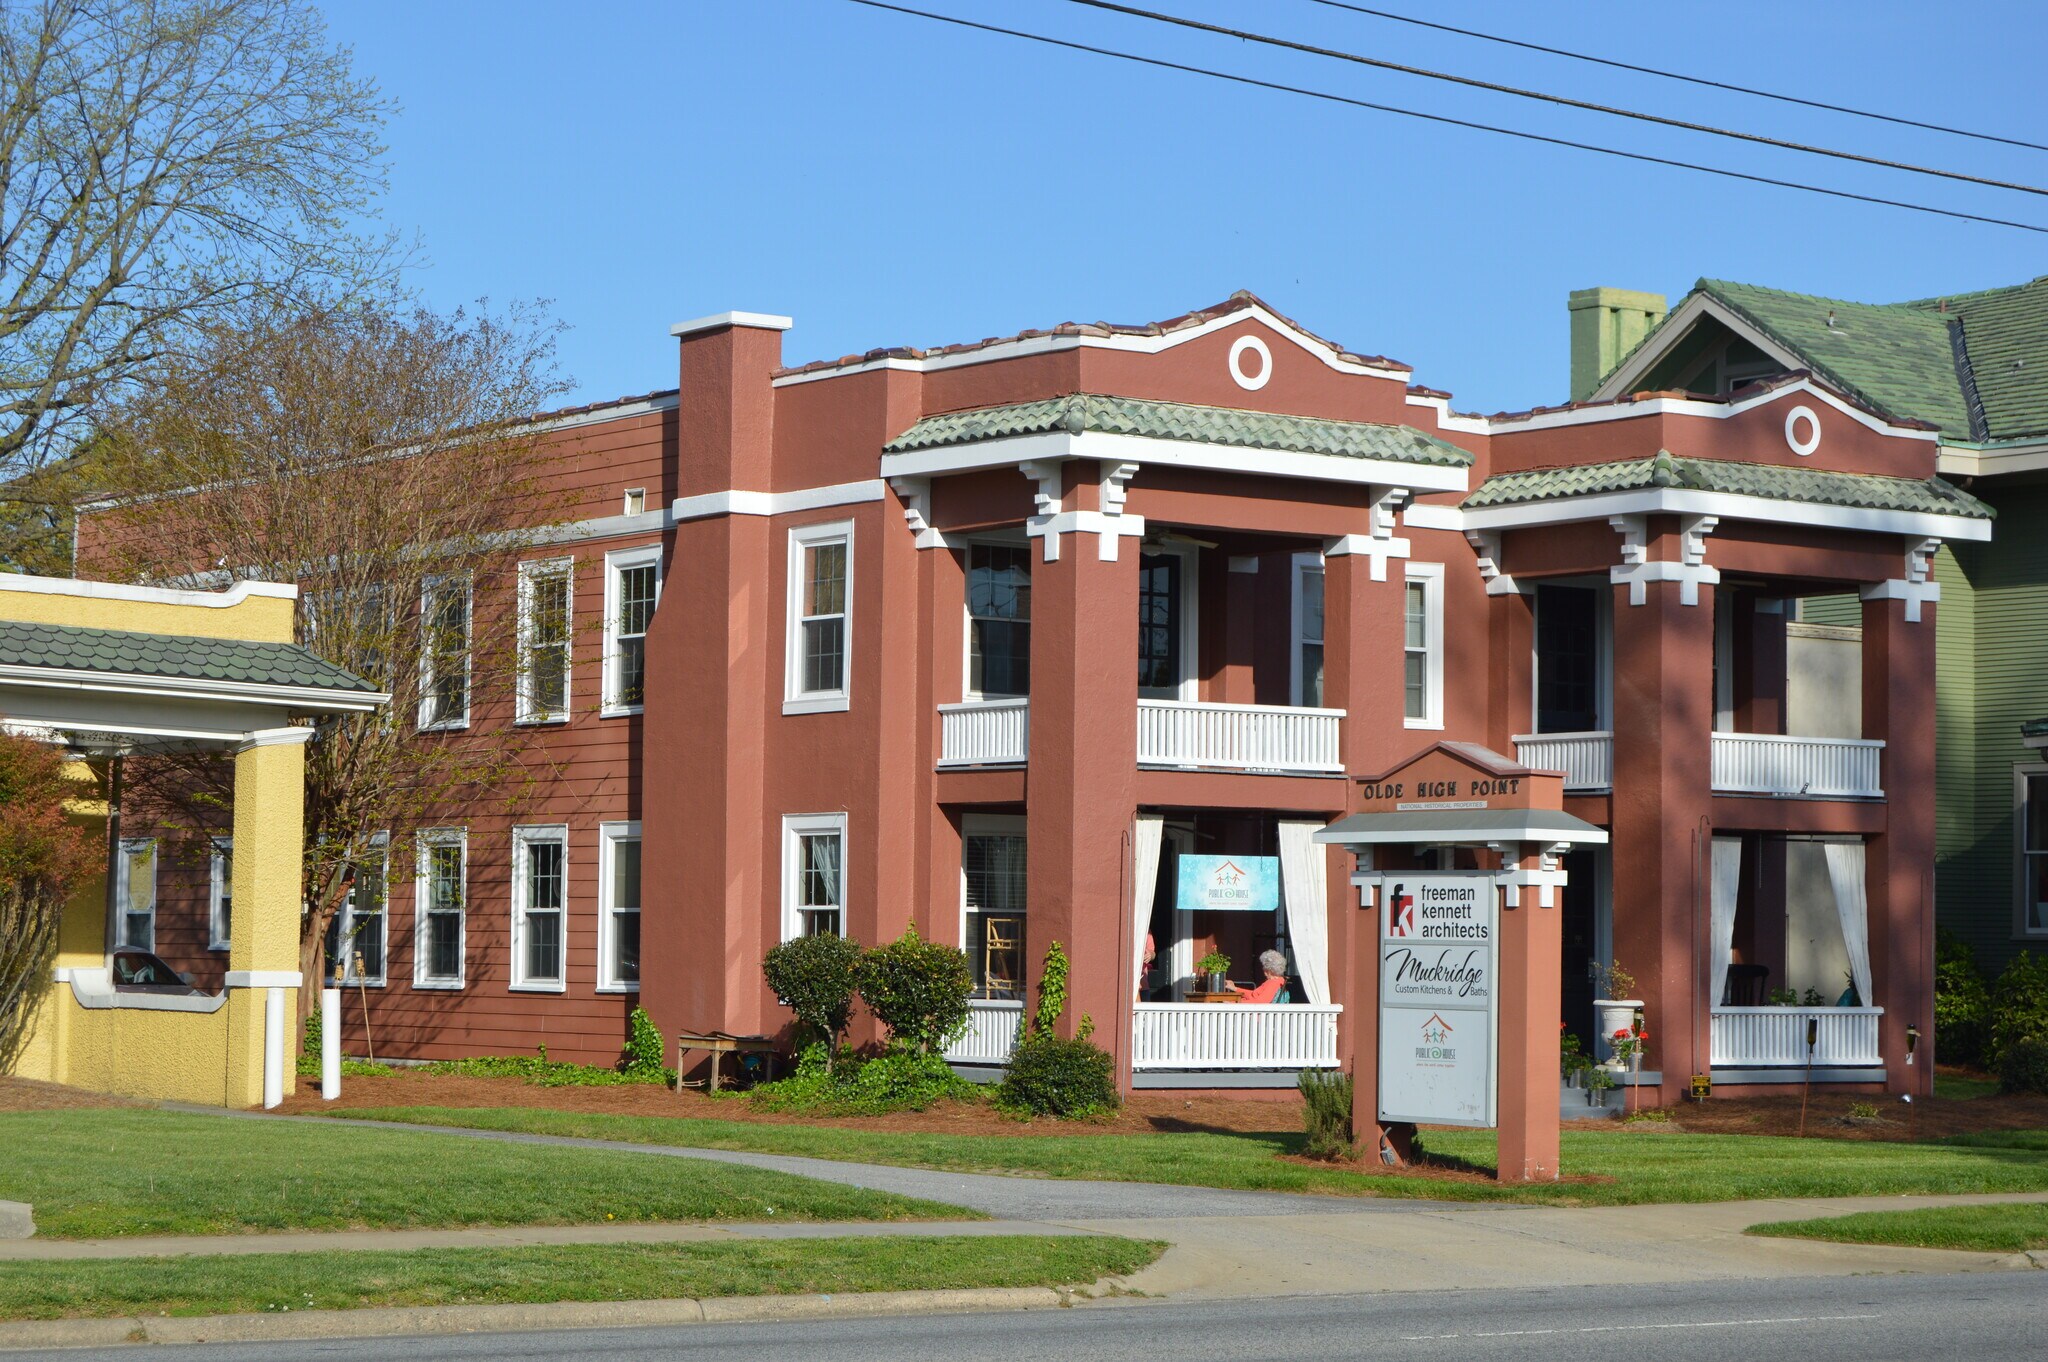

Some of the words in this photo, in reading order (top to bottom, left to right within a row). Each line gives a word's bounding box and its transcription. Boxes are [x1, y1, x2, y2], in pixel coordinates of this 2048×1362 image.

[1364, 783, 1403, 799] OLDE
[1417, 781, 1457, 798] HIGH
[1471, 779, 1519, 796] POINT
[1421, 884, 1475, 901] freeman
[1422, 903, 1472, 919] kennett
[1422, 922, 1488, 938] architects
[1385, 948, 1483, 997] Muckridge
[1395, 984, 1420, 994] Custom
[1420, 985, 1447, 995] Kitchens
[1448, 986, 1453, 995] &
[1470, 986, 1488, 996] Baths
